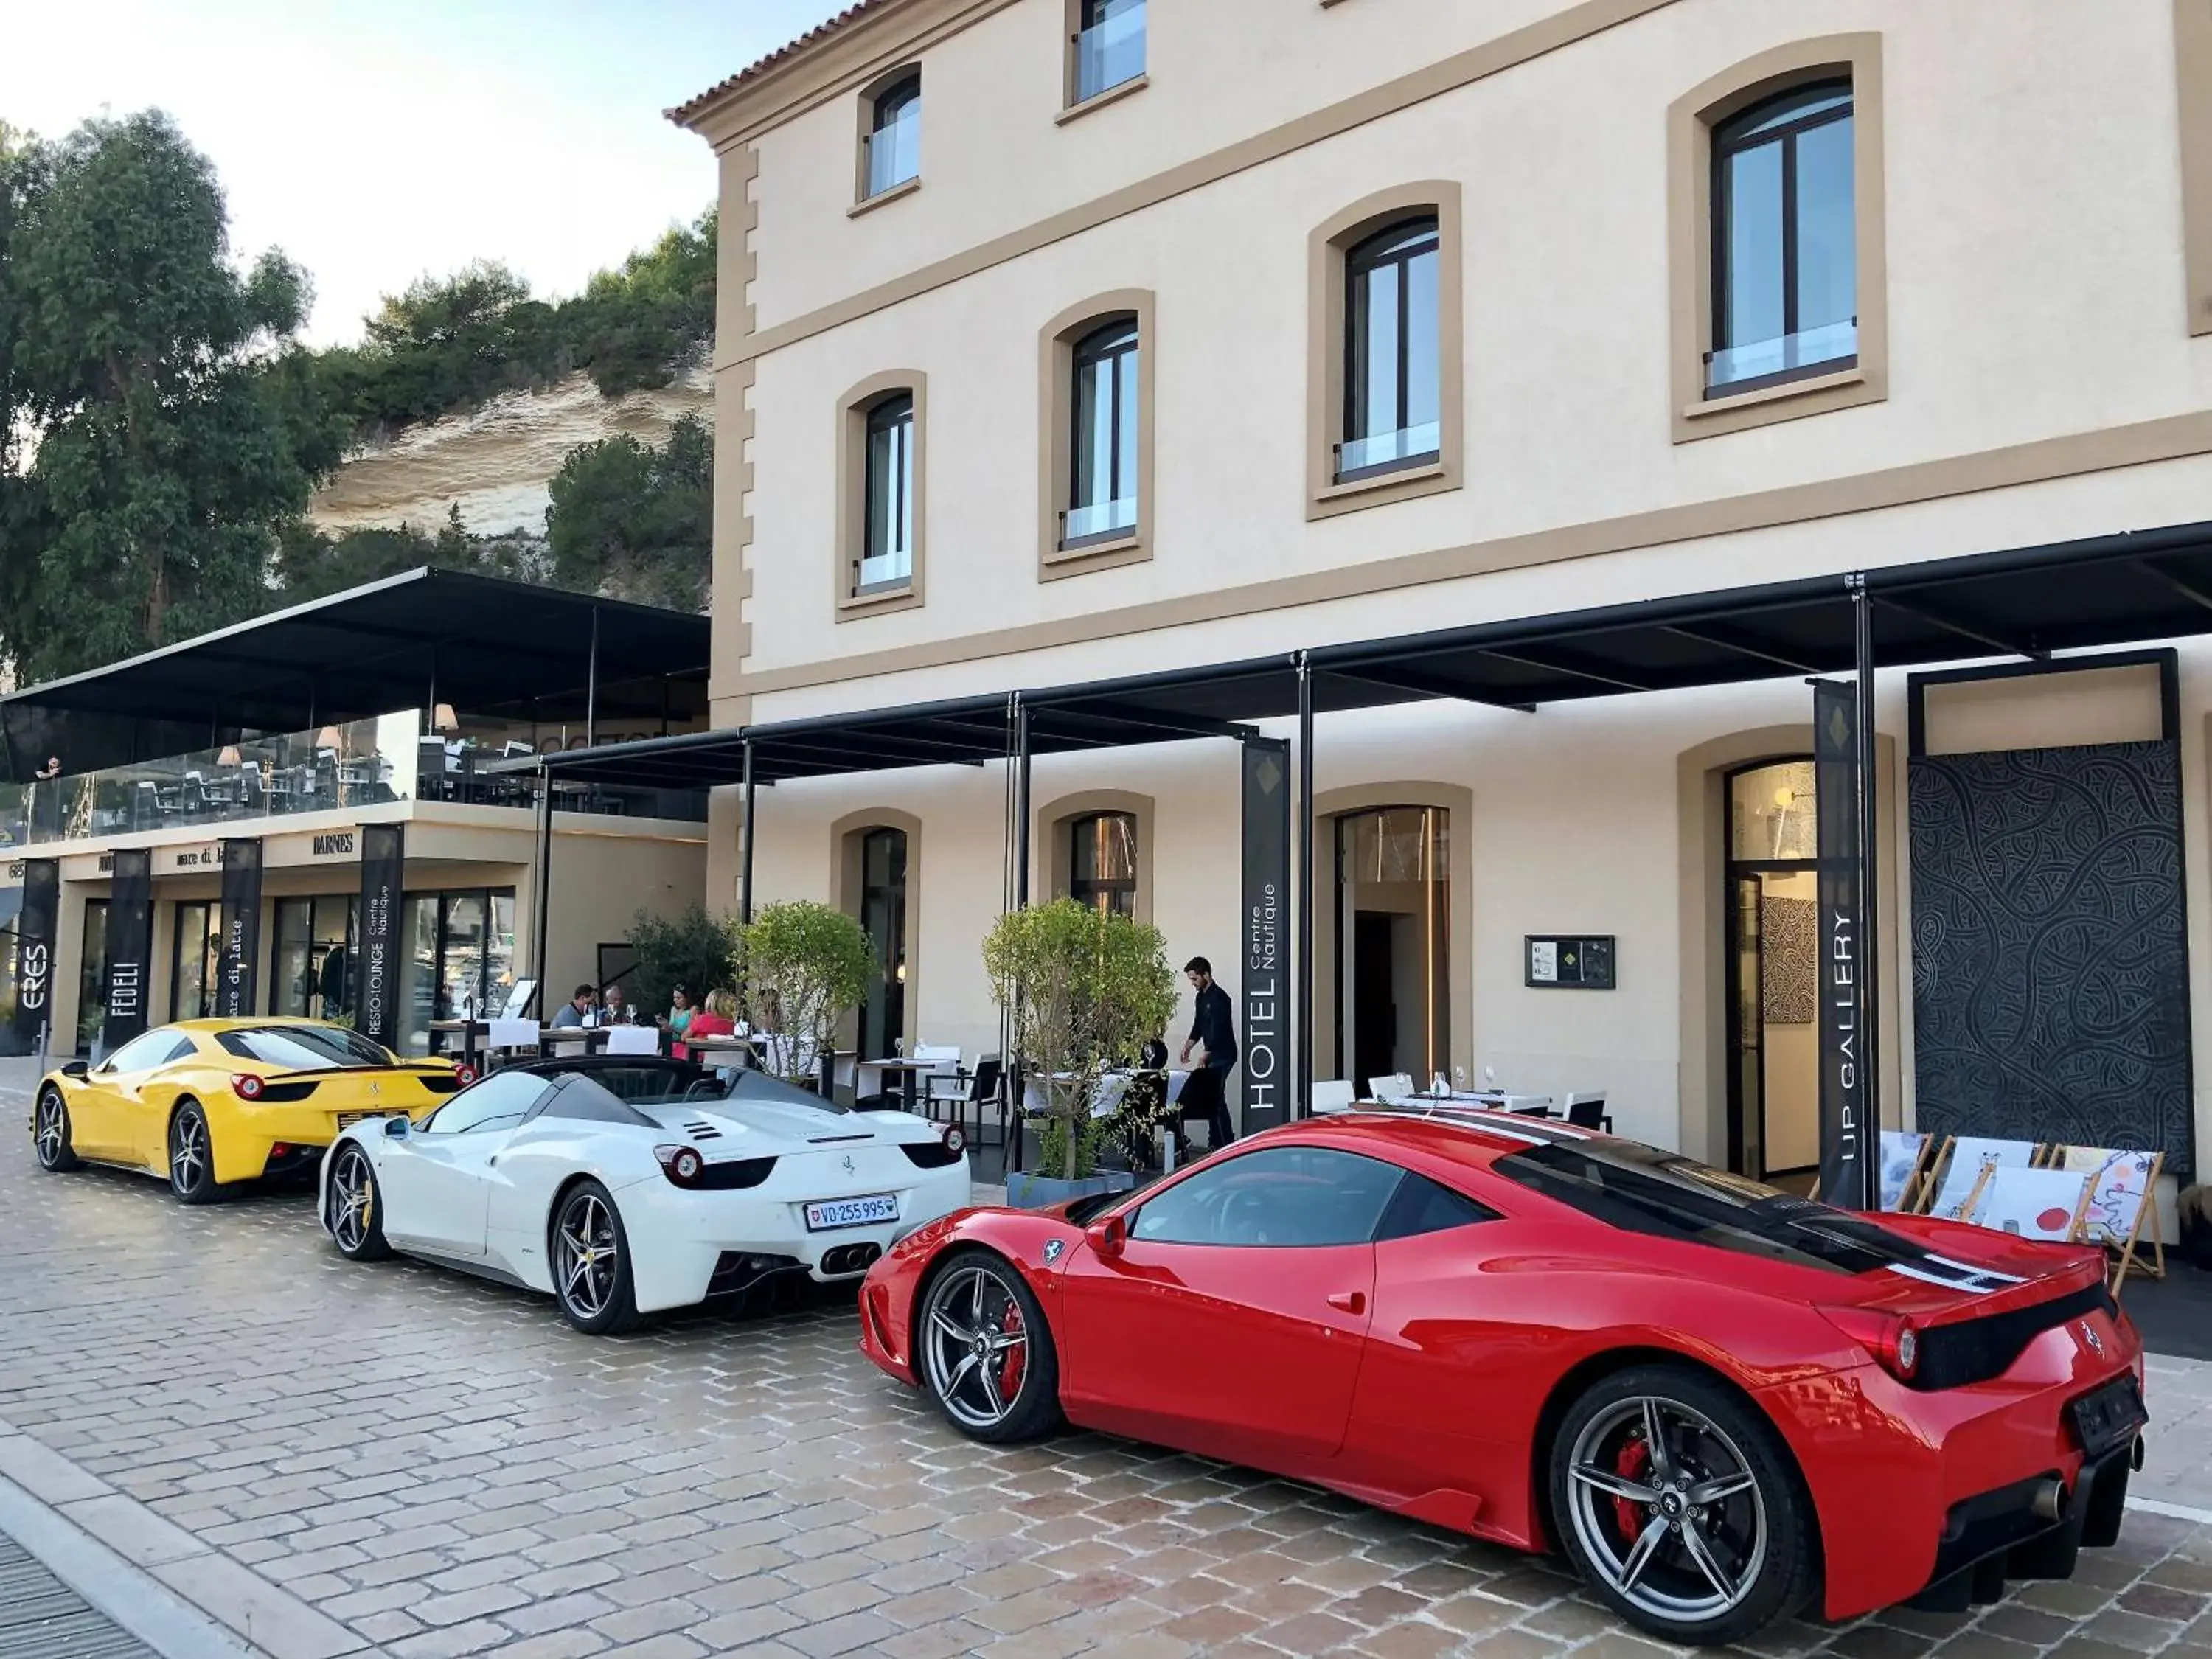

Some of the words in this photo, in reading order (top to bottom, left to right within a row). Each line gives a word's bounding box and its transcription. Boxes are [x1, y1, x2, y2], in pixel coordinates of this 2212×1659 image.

[202, 847, 212, 863] di
[369, 898, 378, 936] Centre
[378, 886, 389, 936] Nautique
[1250, 905, 1260, 970] Centre
[1262, 884, 1277, 970] Nautique
[229, 919, 243, 959] latte
[111, 963, 139, 1017] FEDELI
[228, 970, 240, 984] di
[369, 943, 384, 1035] RESTO-LOUNGE
[1834, 910, 1855, 1089] GALLERY
[1249, 978, 1275, 1109] HOTEL
[1841, 1105, 1856, 1161] UP
